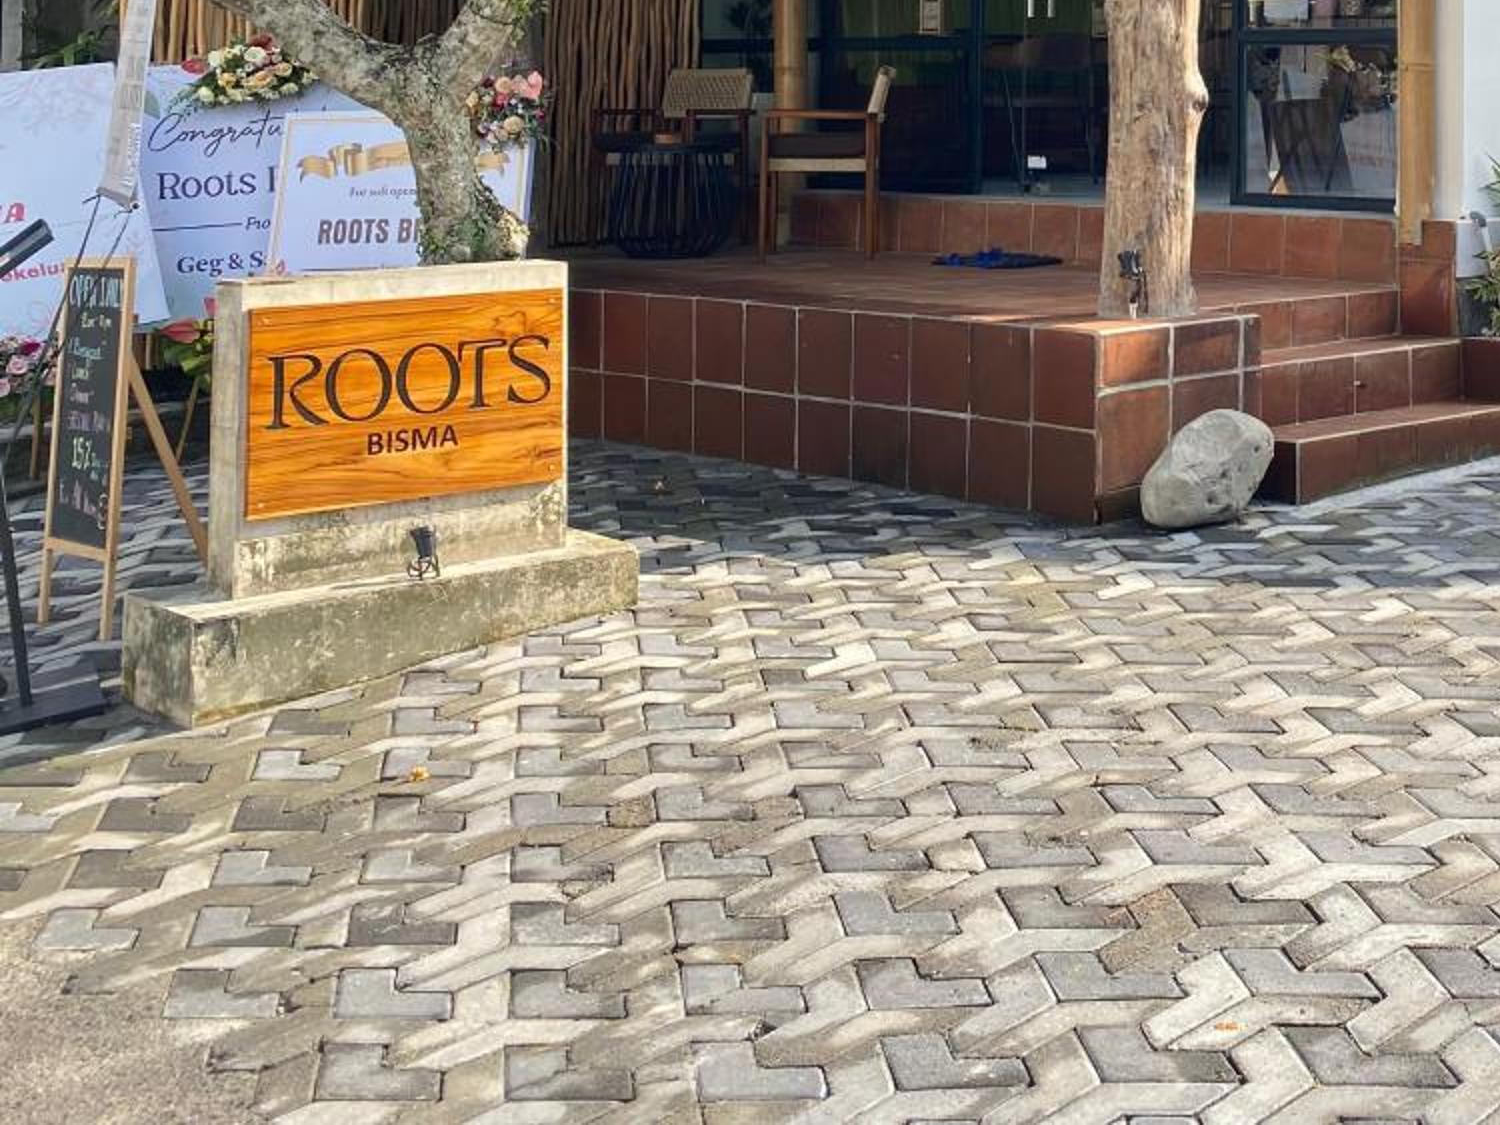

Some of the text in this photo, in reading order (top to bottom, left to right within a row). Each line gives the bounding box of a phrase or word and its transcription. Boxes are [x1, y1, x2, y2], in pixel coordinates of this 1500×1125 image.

[156, 171, 257, 201] Roots
[317, 218, 390, 245] ROOTS
[177, 250, 267, 276] Geg & S
[265, 334, 551, 430] ROOTS
[367, 424, 459, 456] BISMA
